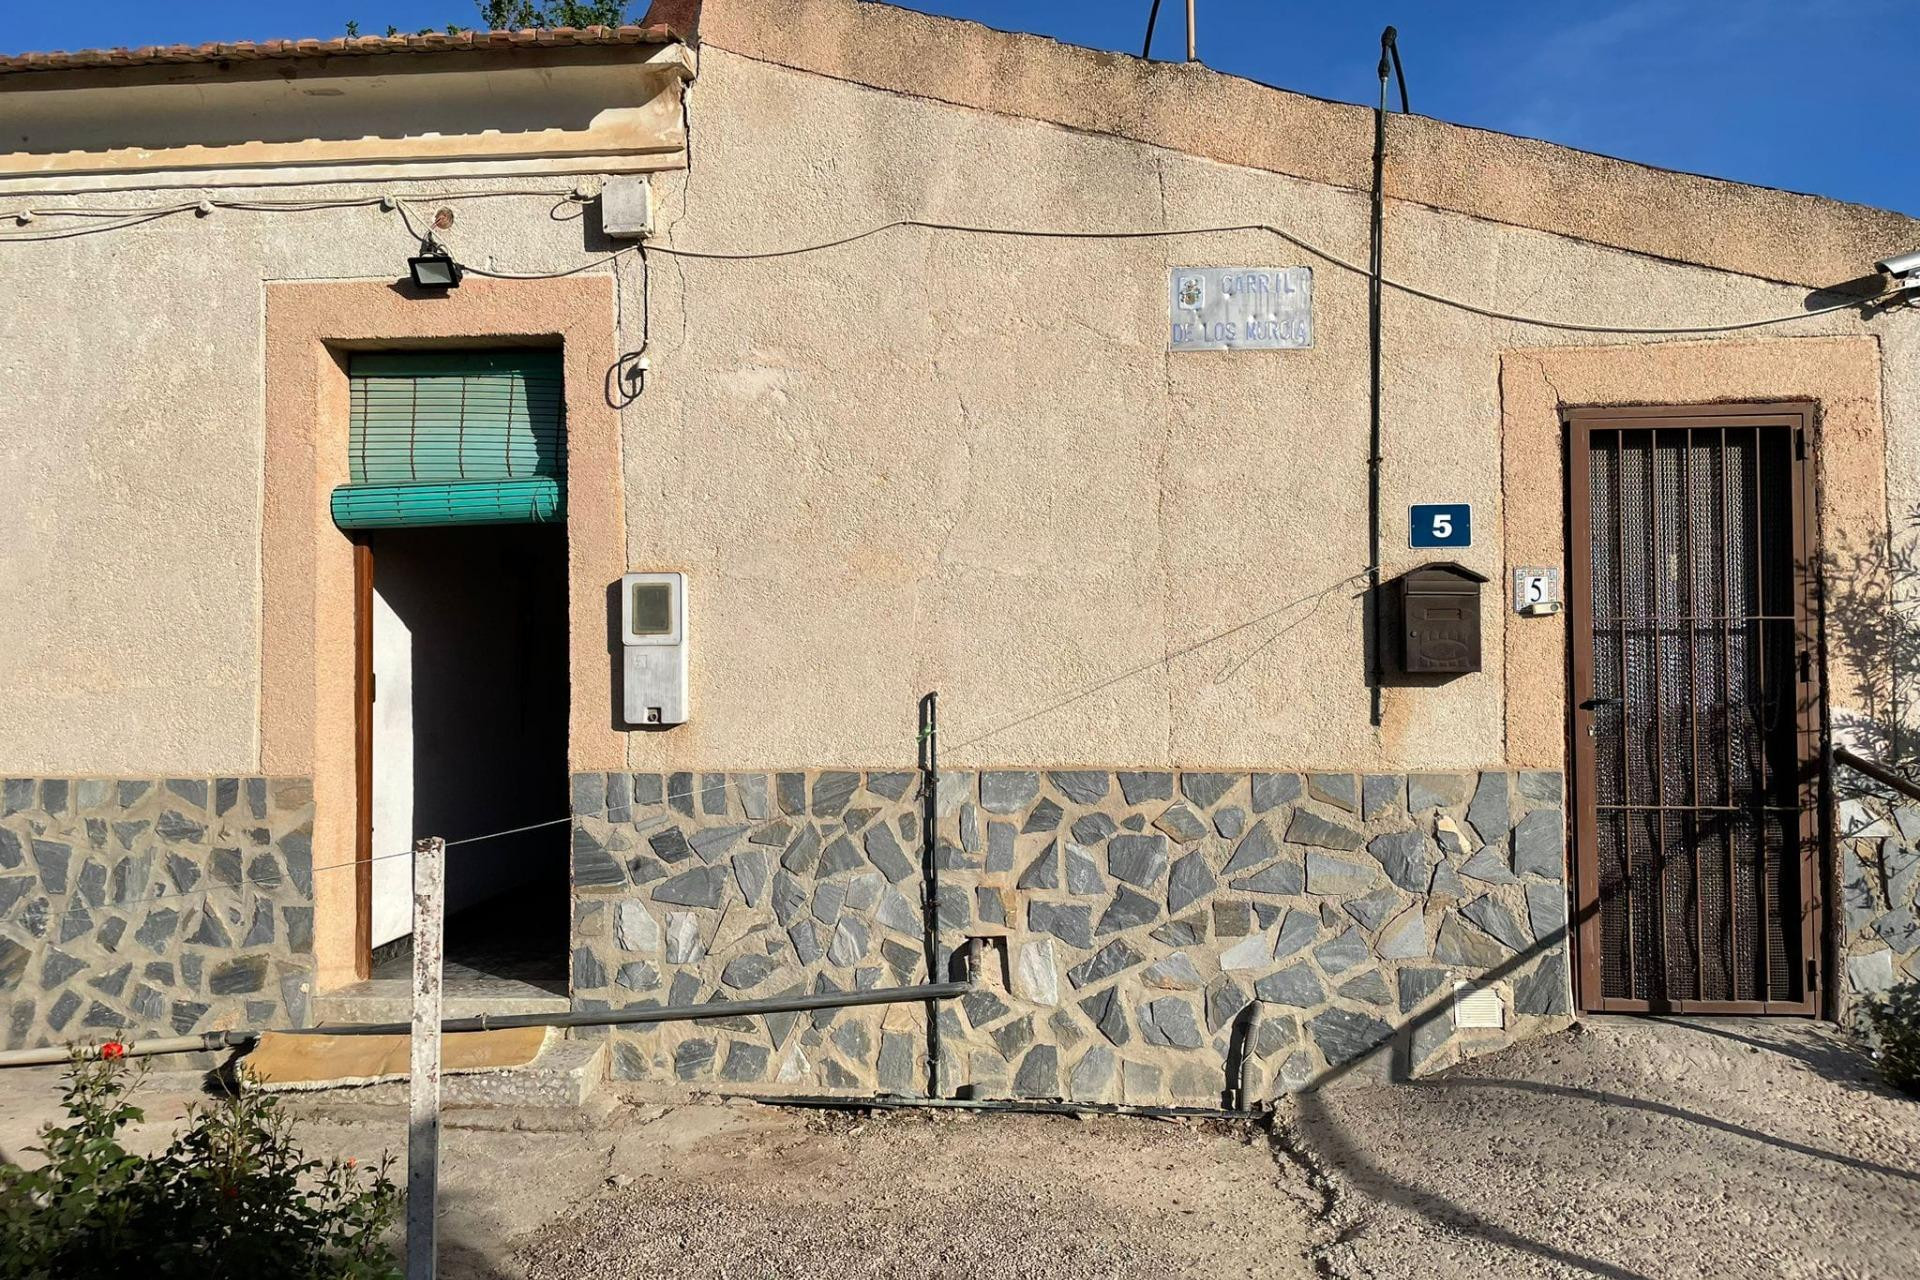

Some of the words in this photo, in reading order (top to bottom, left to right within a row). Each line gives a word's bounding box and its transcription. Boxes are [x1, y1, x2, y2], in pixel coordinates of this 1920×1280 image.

[1221, 272, 1295, 295] CARRIL
[1172, 322, 1195, 343] DE
[1203, 321, 1237, 343] LOS
[1431, 513, 1453, 538] 5
[1530, 577, 1542, 602] 5
